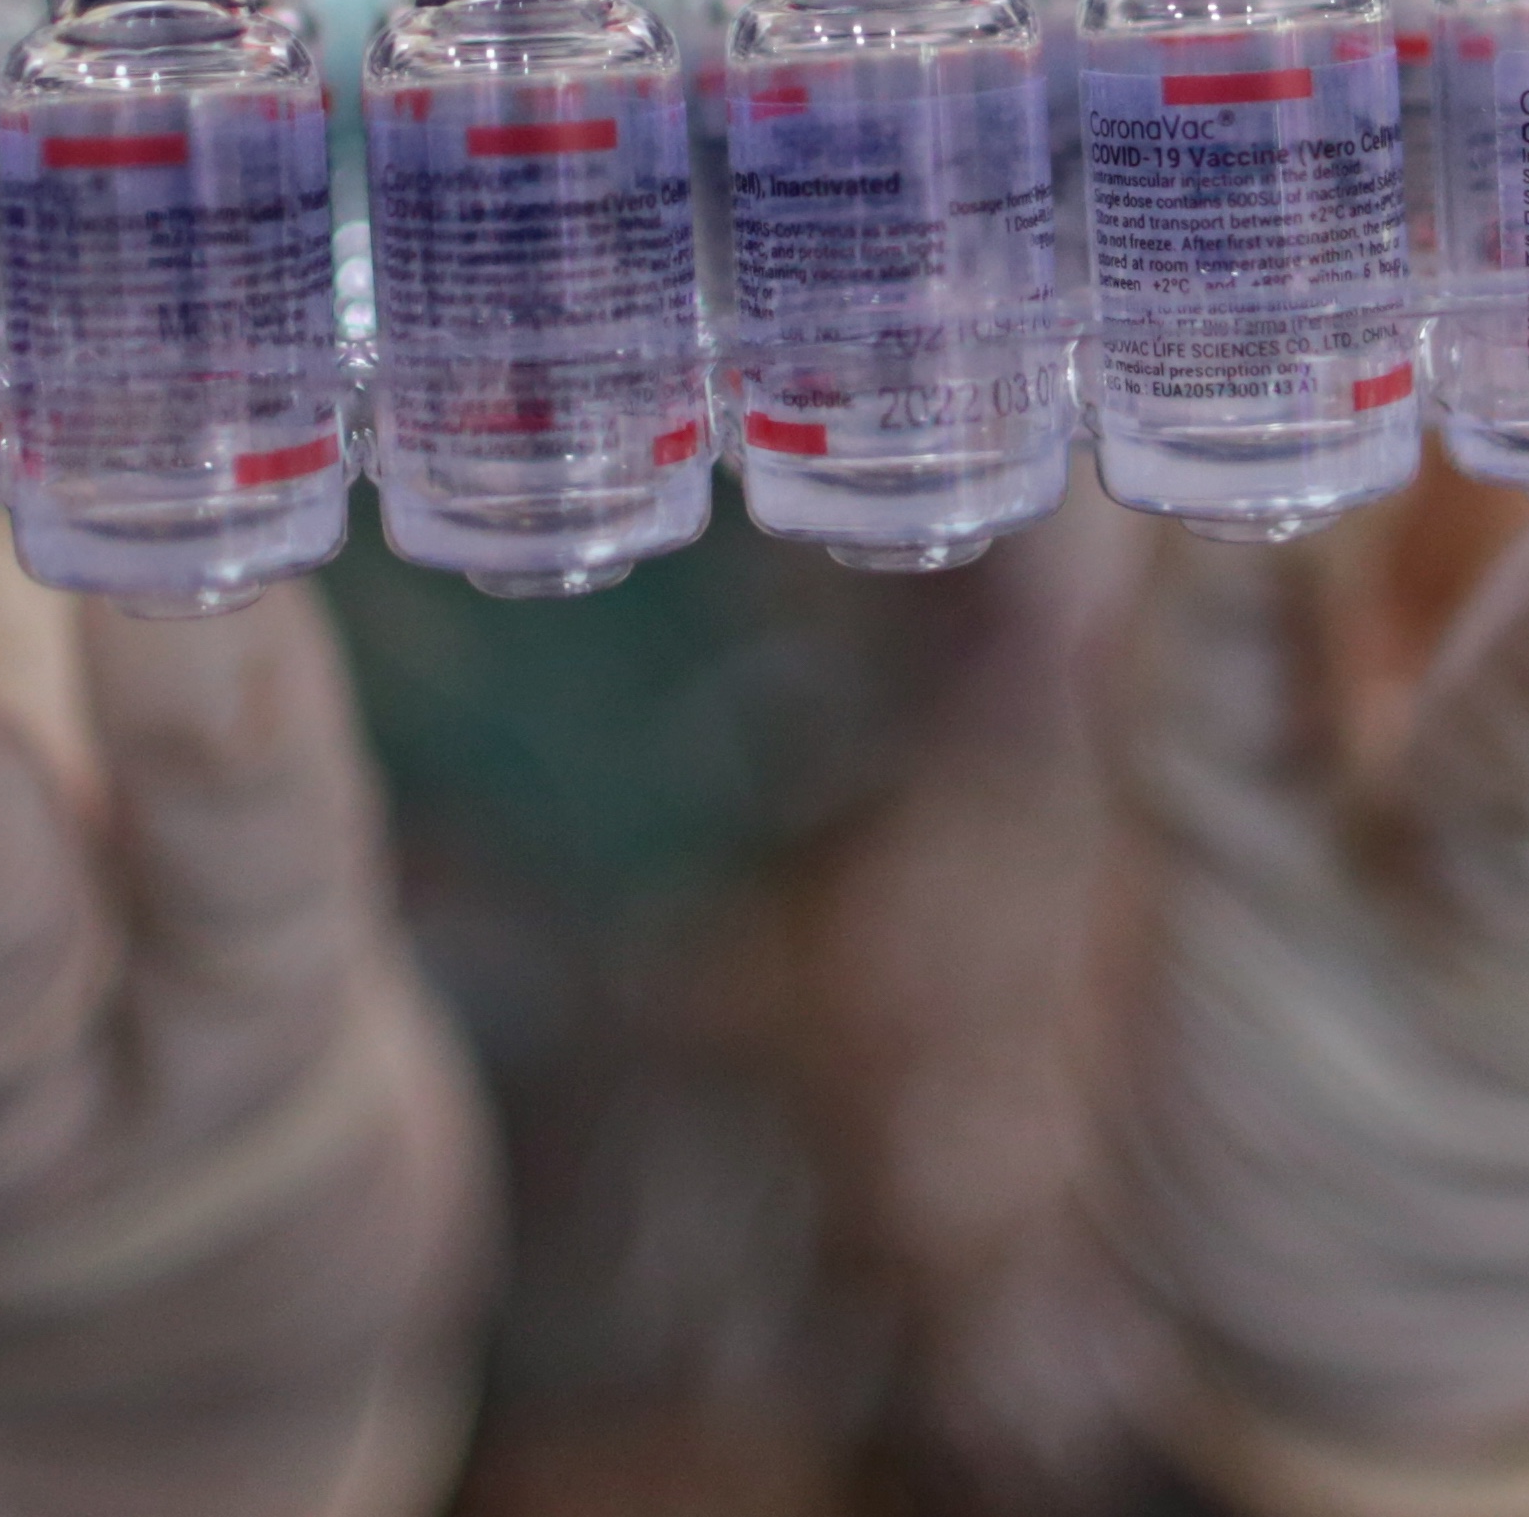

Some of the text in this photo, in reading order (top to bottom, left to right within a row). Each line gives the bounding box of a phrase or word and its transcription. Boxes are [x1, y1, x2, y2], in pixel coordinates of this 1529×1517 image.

[1092, 142, 1181, 168] COVID-19
[1187, 142, 1290, 168] Vaccine
[1299, 139, 1356, 167] (Vero
[1181, 171, 1254, 193] injection
[1282, 168, 1308, 184] the
[1123, 192, 1153, 208] dose
[1157, 194, 1223, 210] contains
[1285, 188, 1304, 205] of
[1122, 214, 1145, 229] and
[1149, 217, 1224, 233] transport
[1230, 215, 1303, 230] between
[1349, 199, 1373, 218] and
[1109, 234, 1127, 249] not
[1181, 234, 1223, 251] After
[1227, 233, 1261, 250] first
[1132, 257, 1144, 272] at
[1149, 260, 1189, 273] room
[1308, 248, 1353, 266] within
[1358, 241, 1365, 258] 1
[1154, 342, 1186, 359] LIFE
[1192, 341, 1280, 359] SCIENCES
[1115, 360, 1164, 377] medical
[1168, 363, 1272, 382] prescription
